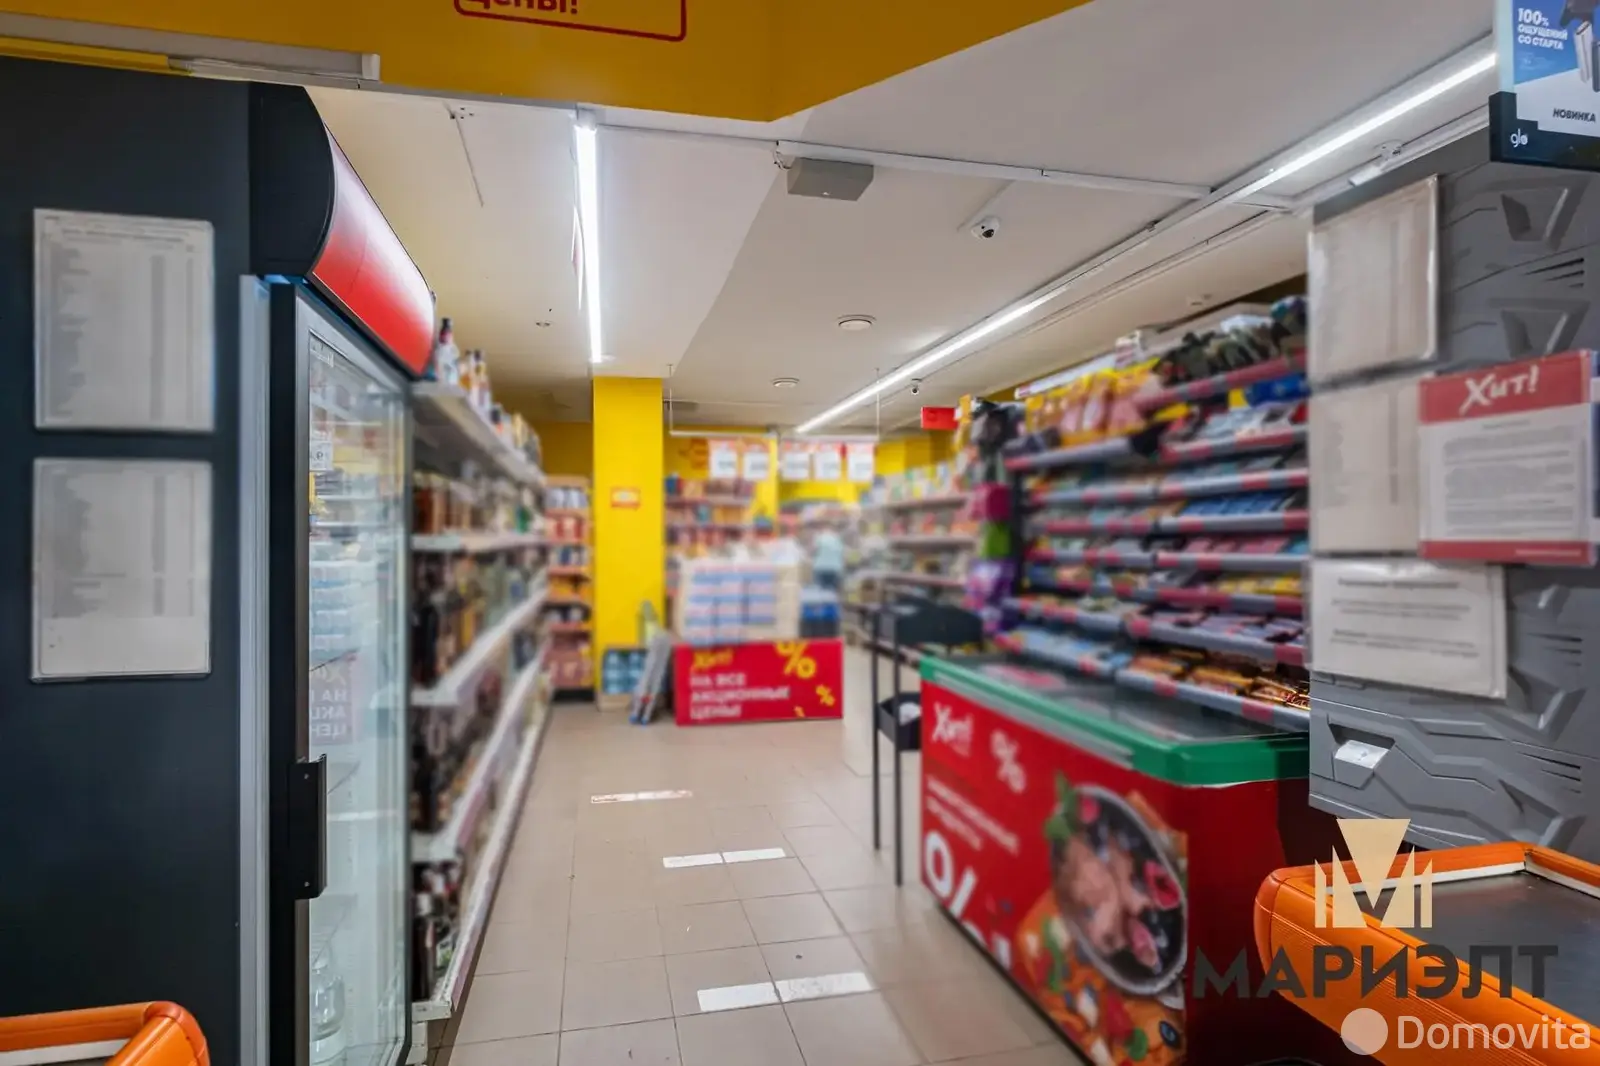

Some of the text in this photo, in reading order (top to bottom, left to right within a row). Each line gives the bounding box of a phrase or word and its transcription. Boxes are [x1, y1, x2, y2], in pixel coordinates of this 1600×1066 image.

[1517, 8, 1550, 27] 100%
[1518, 24, 1568, 41] ОЩУЩЕНИЙ
[1518, 35, 1564, 51] СО СТАРТА
[1552, 107, 1597, 123] НОВИНКА
[1510, 128, 1529, 148] glo
[1459, 364, 1540, 416] Хит!
